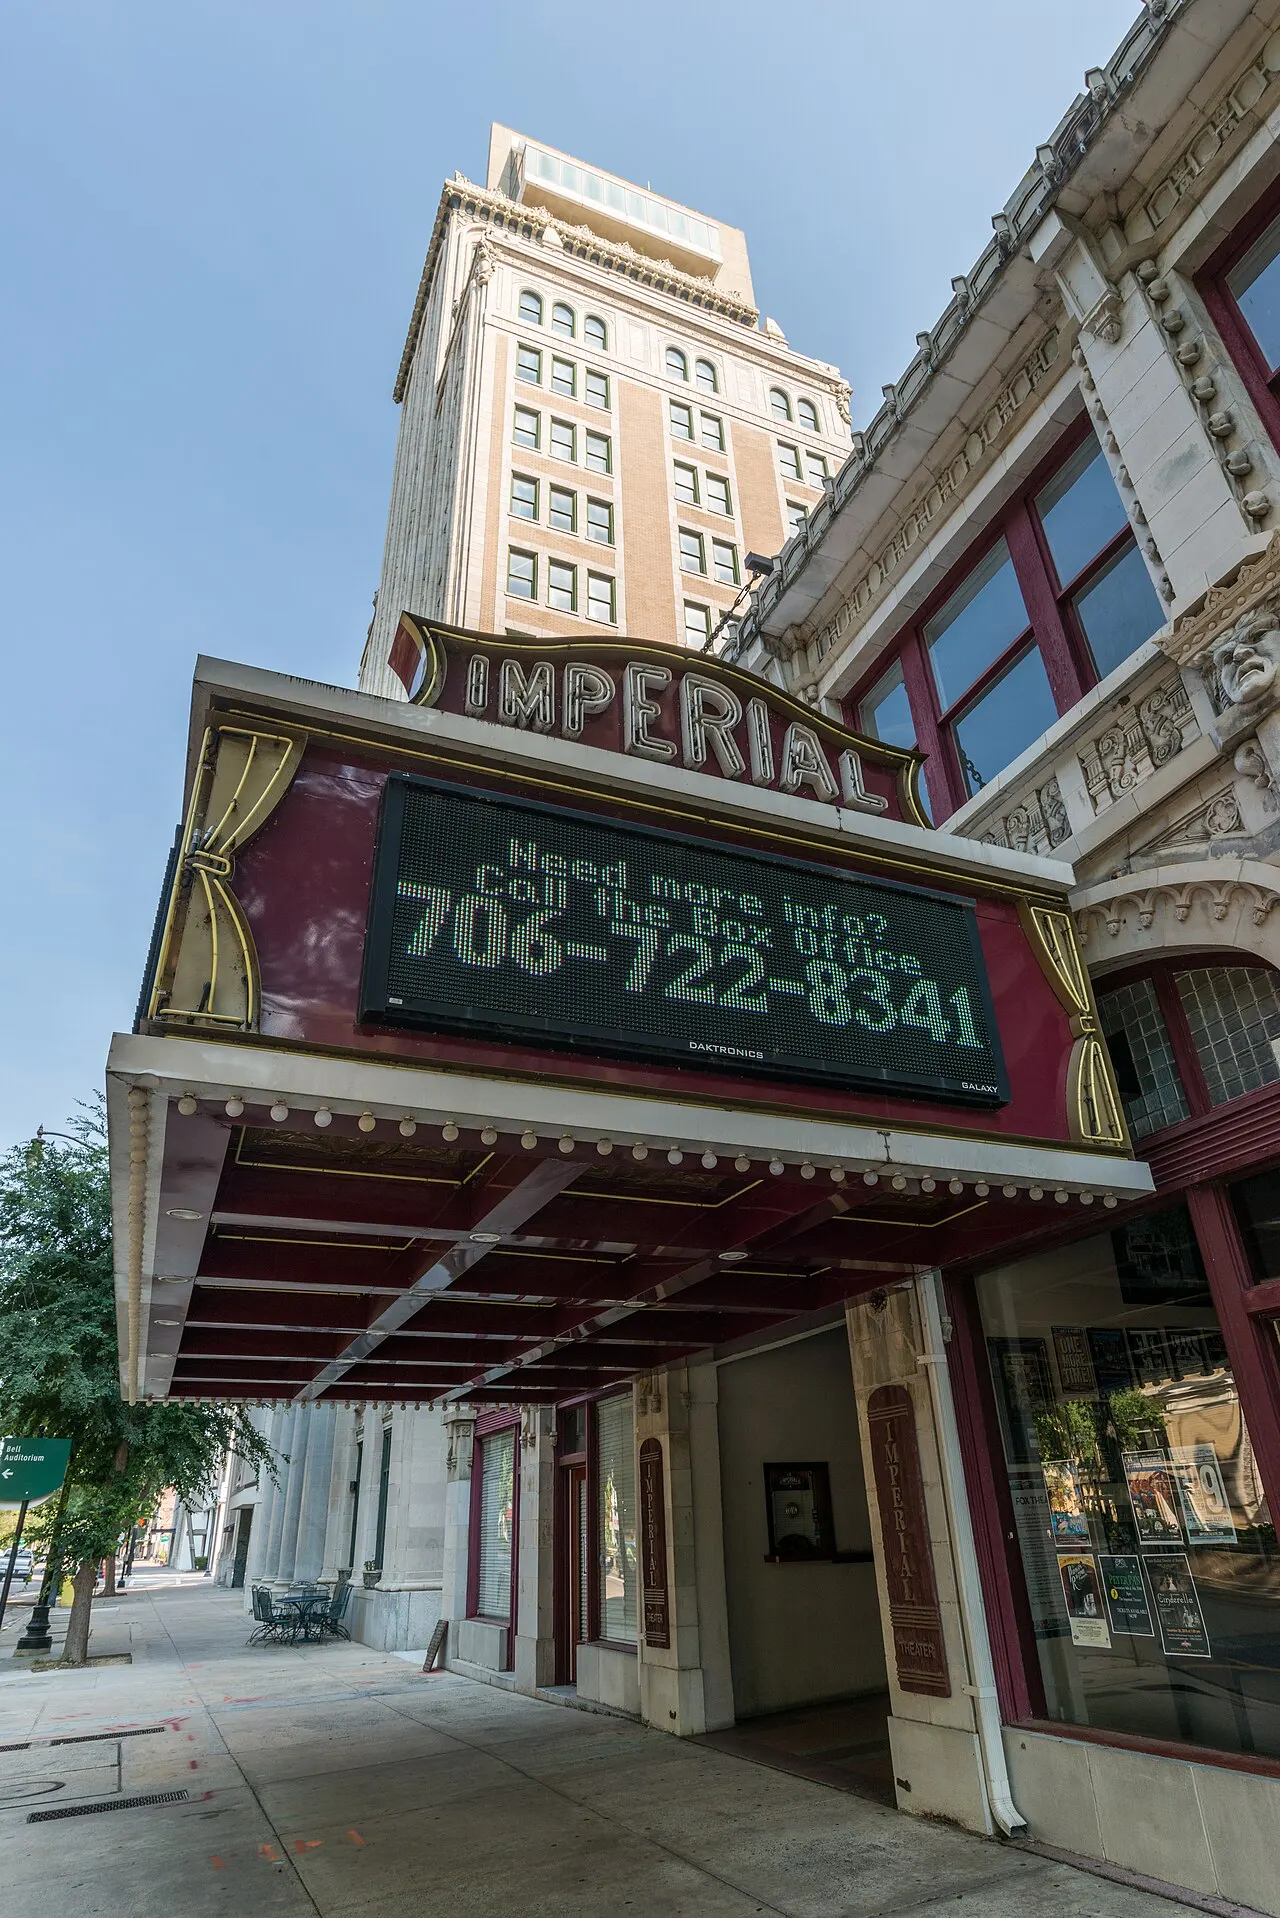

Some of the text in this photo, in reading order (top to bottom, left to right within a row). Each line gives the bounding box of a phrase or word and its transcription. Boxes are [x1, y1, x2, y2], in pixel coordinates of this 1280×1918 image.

[465, 653, 889, 815] IMPERIAL
[510, 838, 888, 941] Need more info?
[476, 864, 922, 975] Call the Box Office
[397, 881, 984, 1048] 706-722-8341
[689, 1041, 764, 1059] DAKTRONICS
[961, 1081, 998, 1093] GALAXY
[1060, 1336, 1082, 1353] ONE
[1063, 1353, 1086, 1367] MORE
[1015, 1496, 1030, 1505] FOX
[885, 1421, 916, 1603] IMPERIAL
[646, 1464, 657, 1587] IMPERIAL
[1157, 1593, 1194, 1606] Cinderella
[898, 1641, 936, 1658] THEATER
